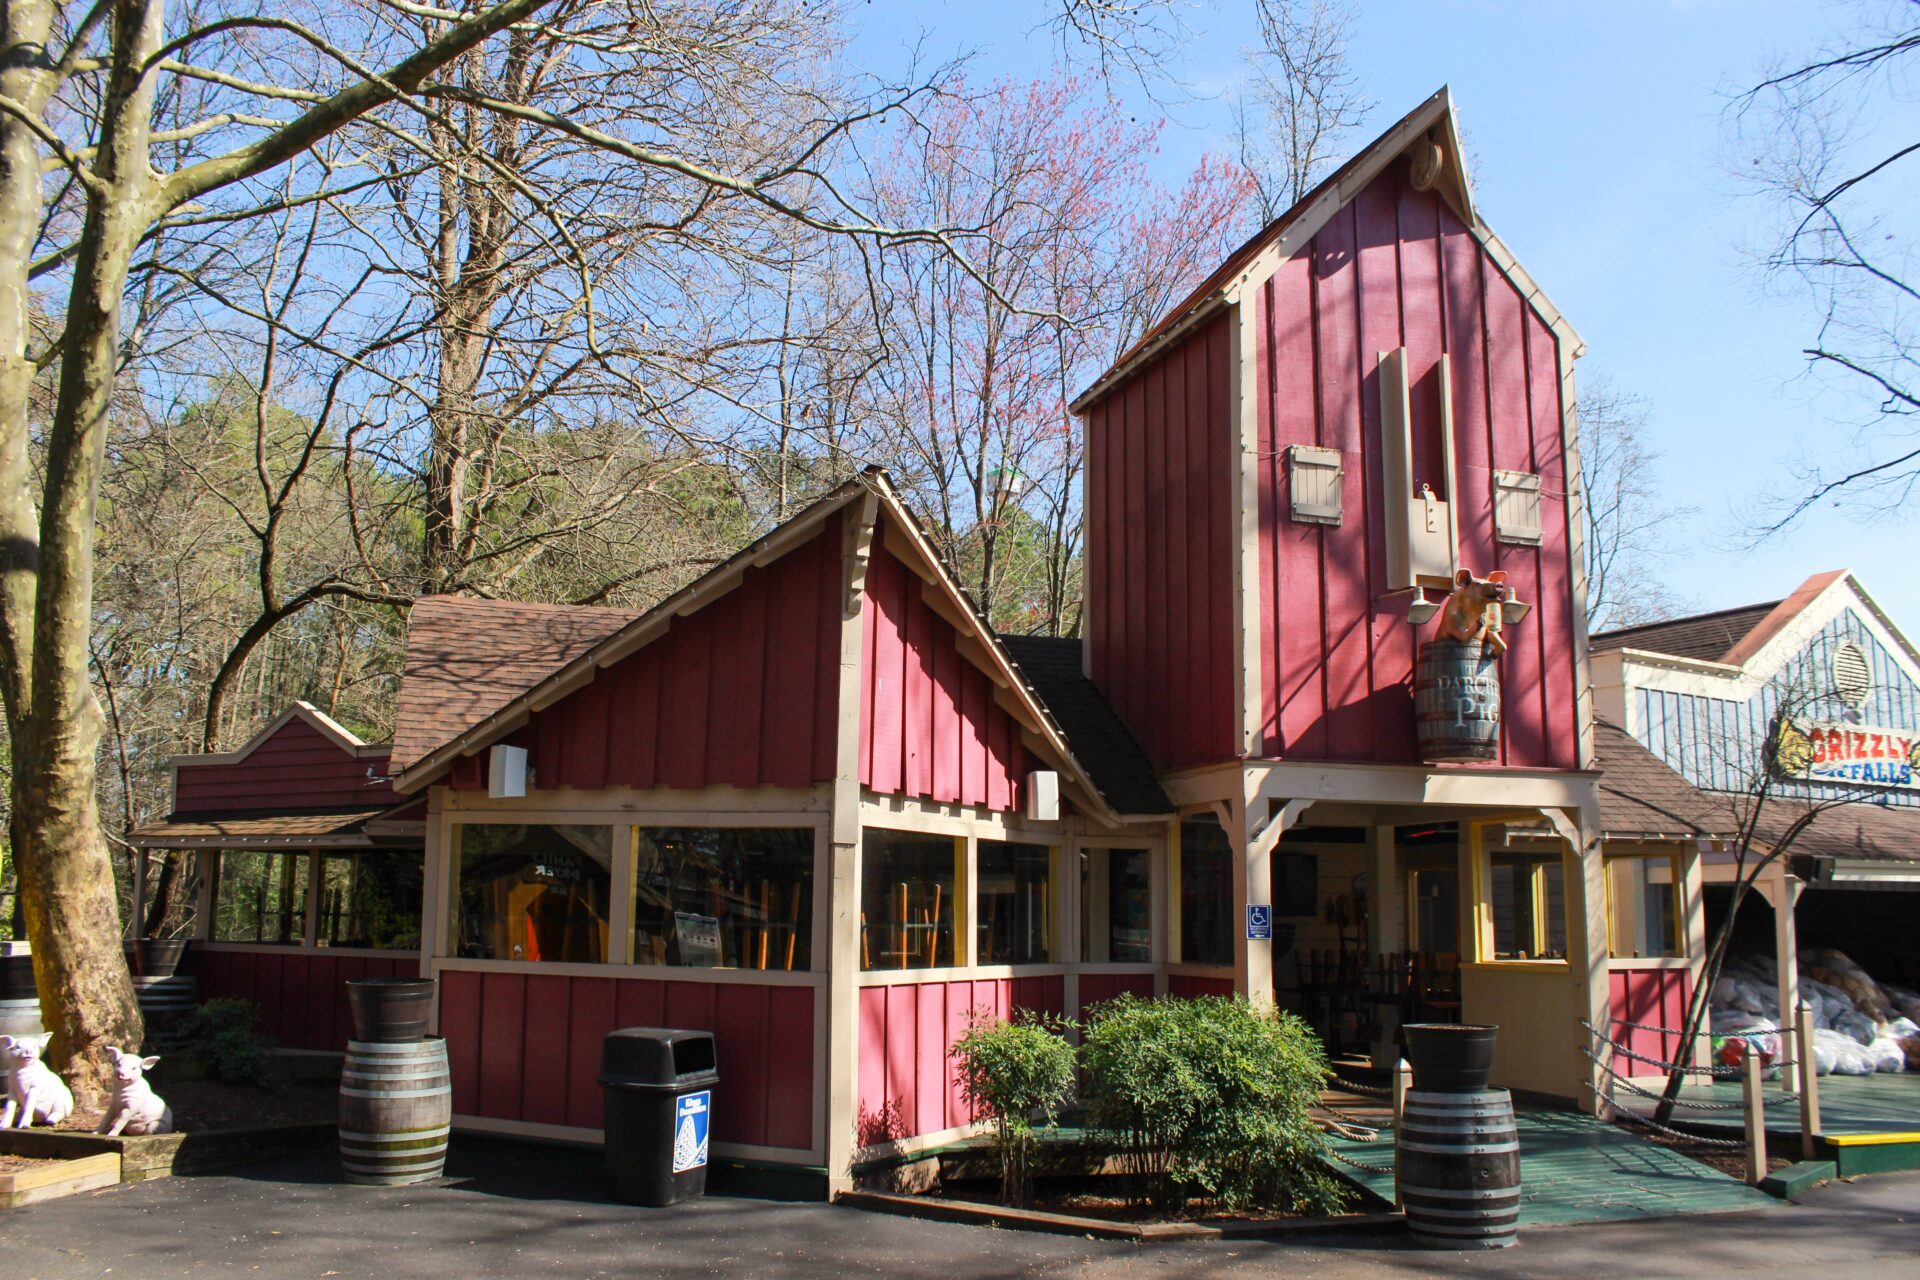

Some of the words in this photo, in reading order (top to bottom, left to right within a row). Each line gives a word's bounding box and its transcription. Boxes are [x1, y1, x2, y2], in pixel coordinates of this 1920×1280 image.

[1454, 697, 1499, 727] PIG
[1810, 727, 1912, 764] GRIZZLY
[1850, 761, 1912, 785] FALLS
